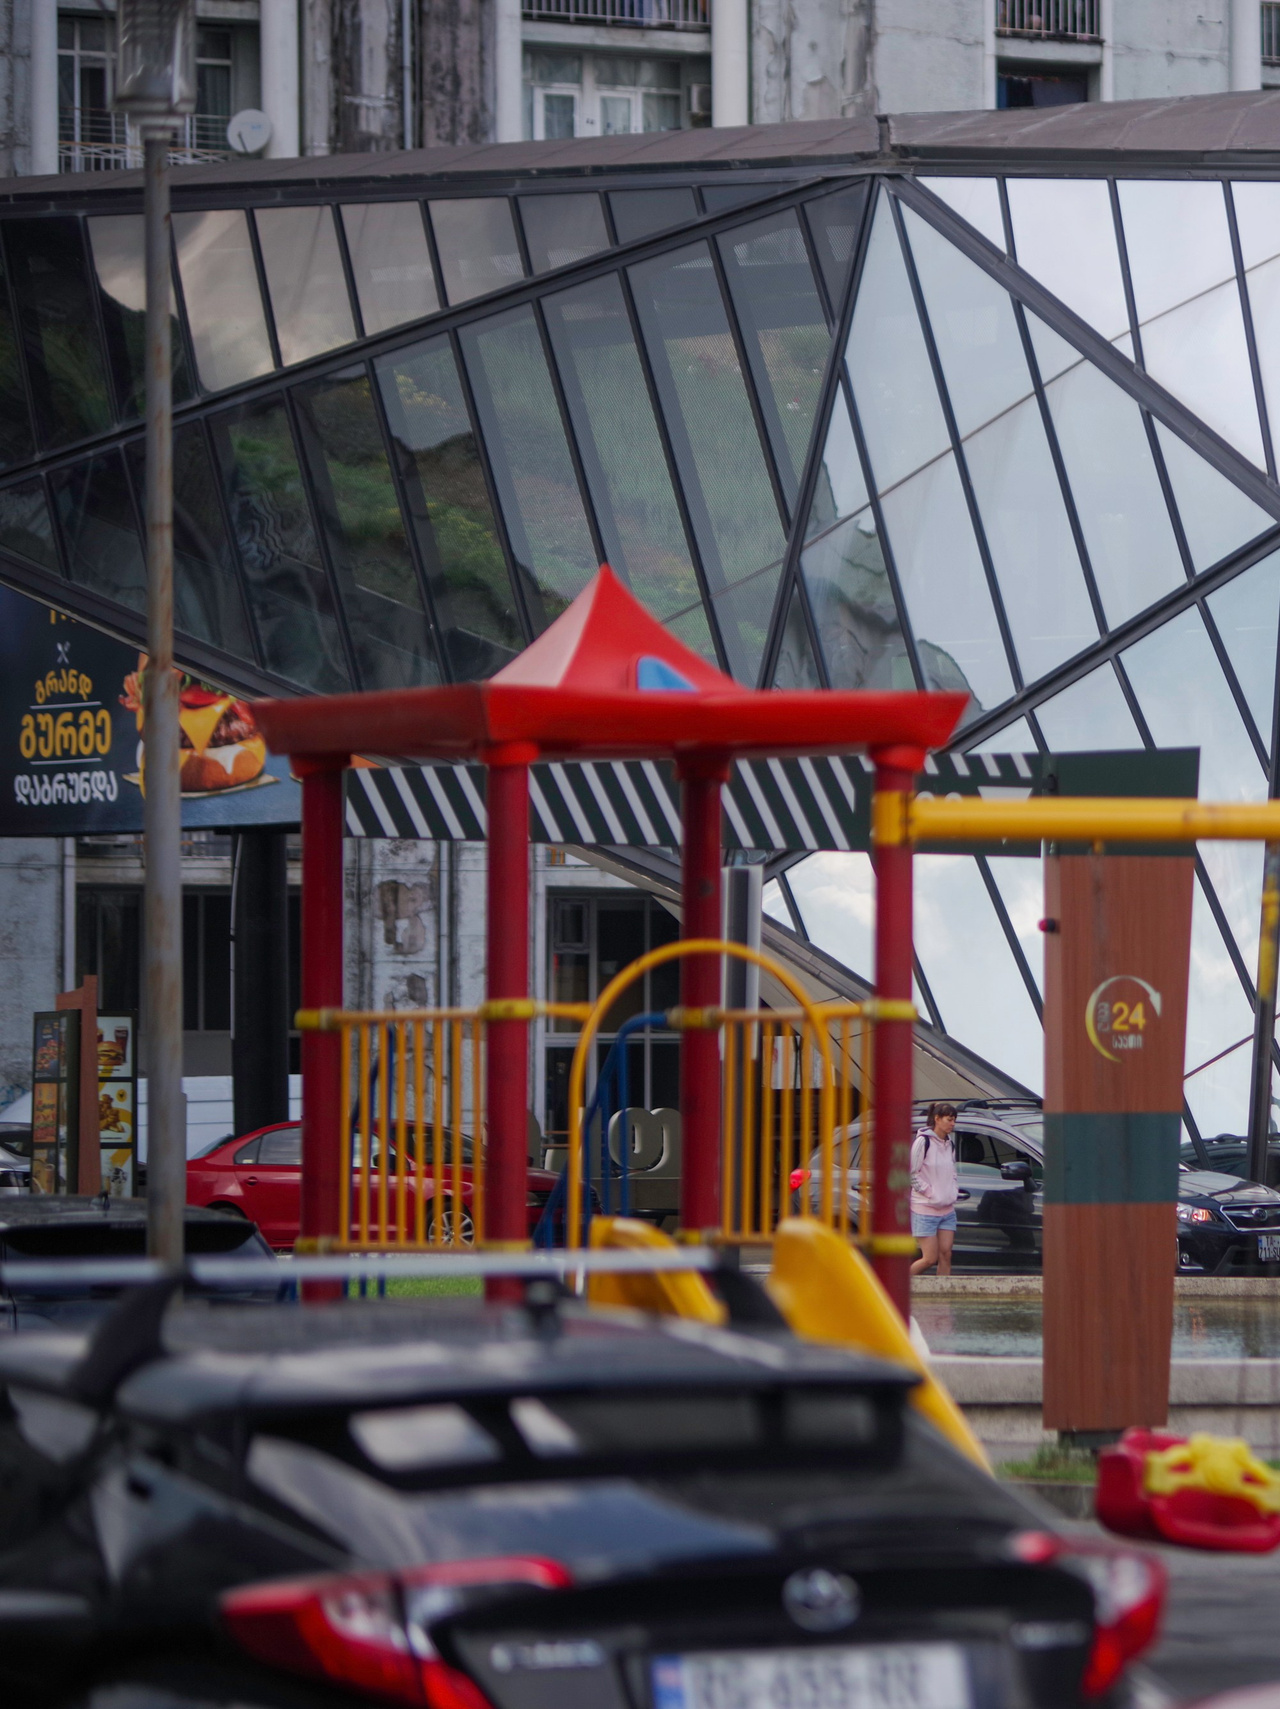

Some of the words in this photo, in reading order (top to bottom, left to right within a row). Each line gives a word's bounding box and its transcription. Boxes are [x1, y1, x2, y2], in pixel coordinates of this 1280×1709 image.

[35, 668, 93, 704] გრანდ
[20, 708, 112, 758] გურმე
[14, 770, 118, 805] დაბრუნდა
[1112, 1001, 1146, 1030] 24
